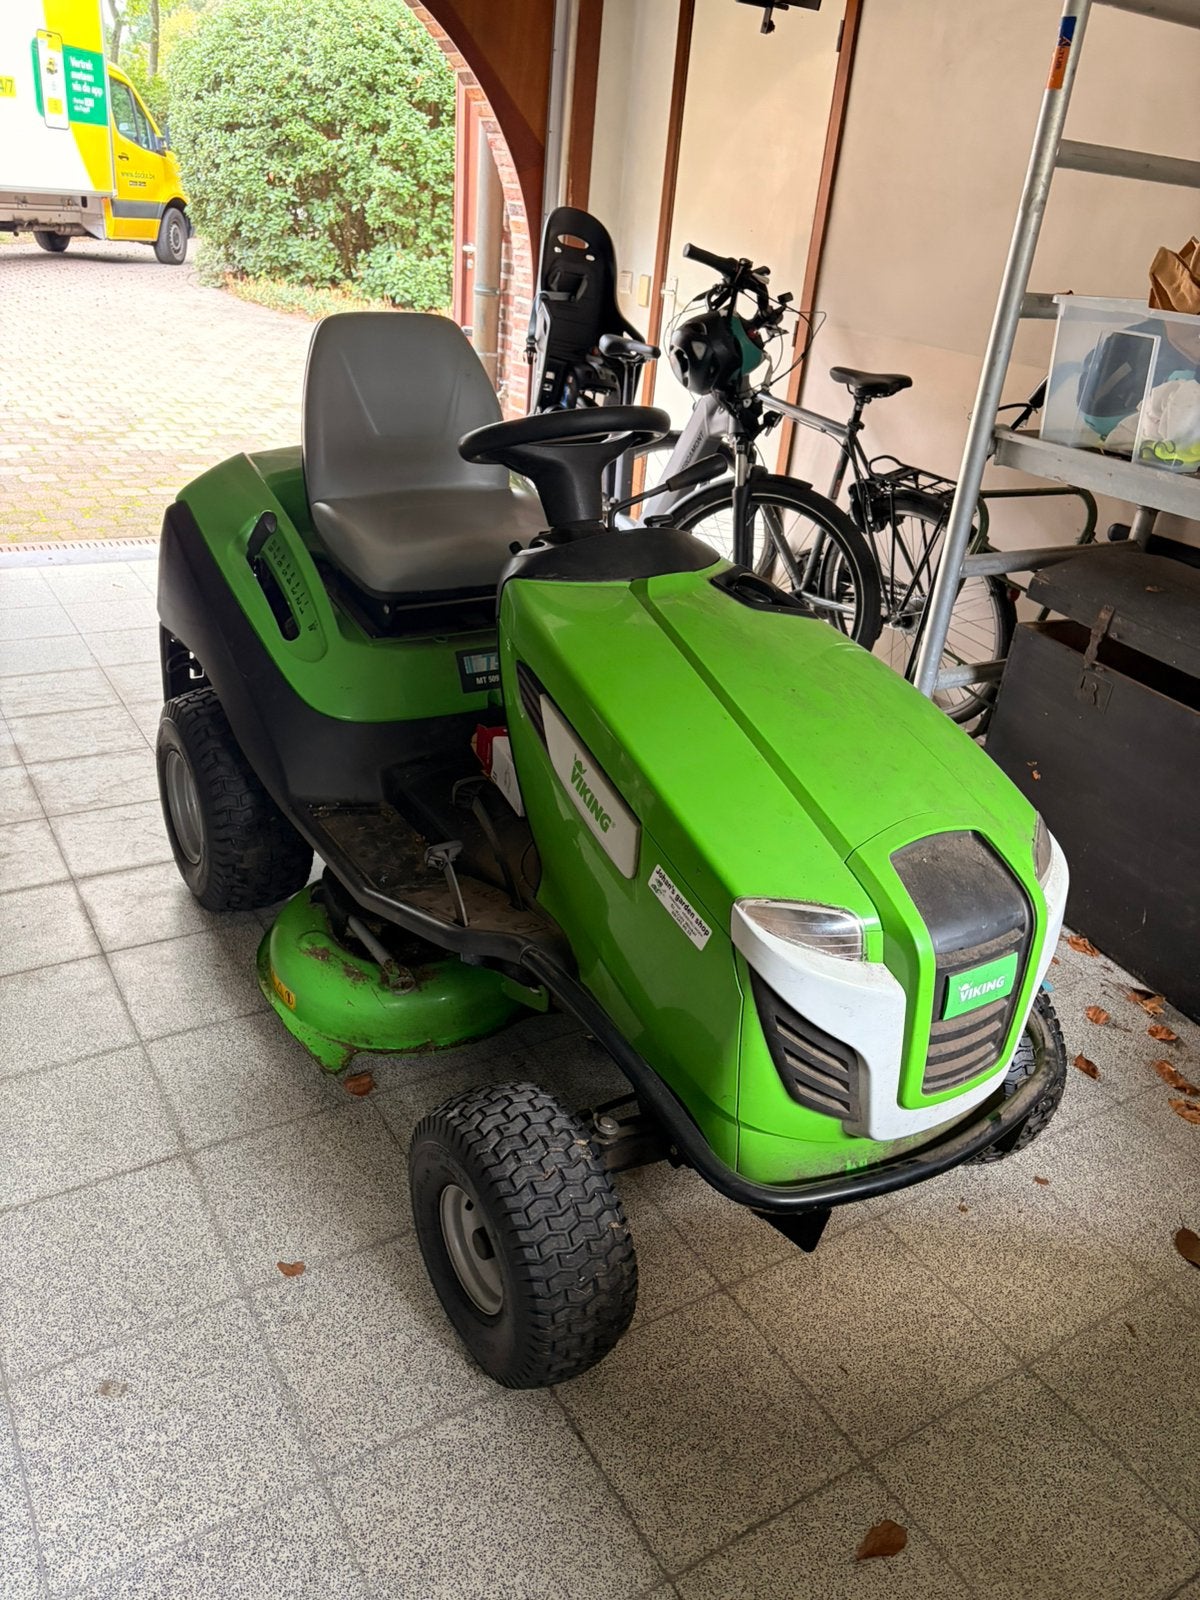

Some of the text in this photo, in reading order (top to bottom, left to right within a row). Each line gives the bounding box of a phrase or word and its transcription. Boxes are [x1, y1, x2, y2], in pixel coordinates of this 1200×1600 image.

[476, 676, 487, 685] MT
[571, 764, 612, 833] VIKING
[655, 868, 675, 895] Johan's
[674, 894, 695, 918] garden
[695, 916, 710, 936] shop
[959, 975, 1006, 1003] VIKING
